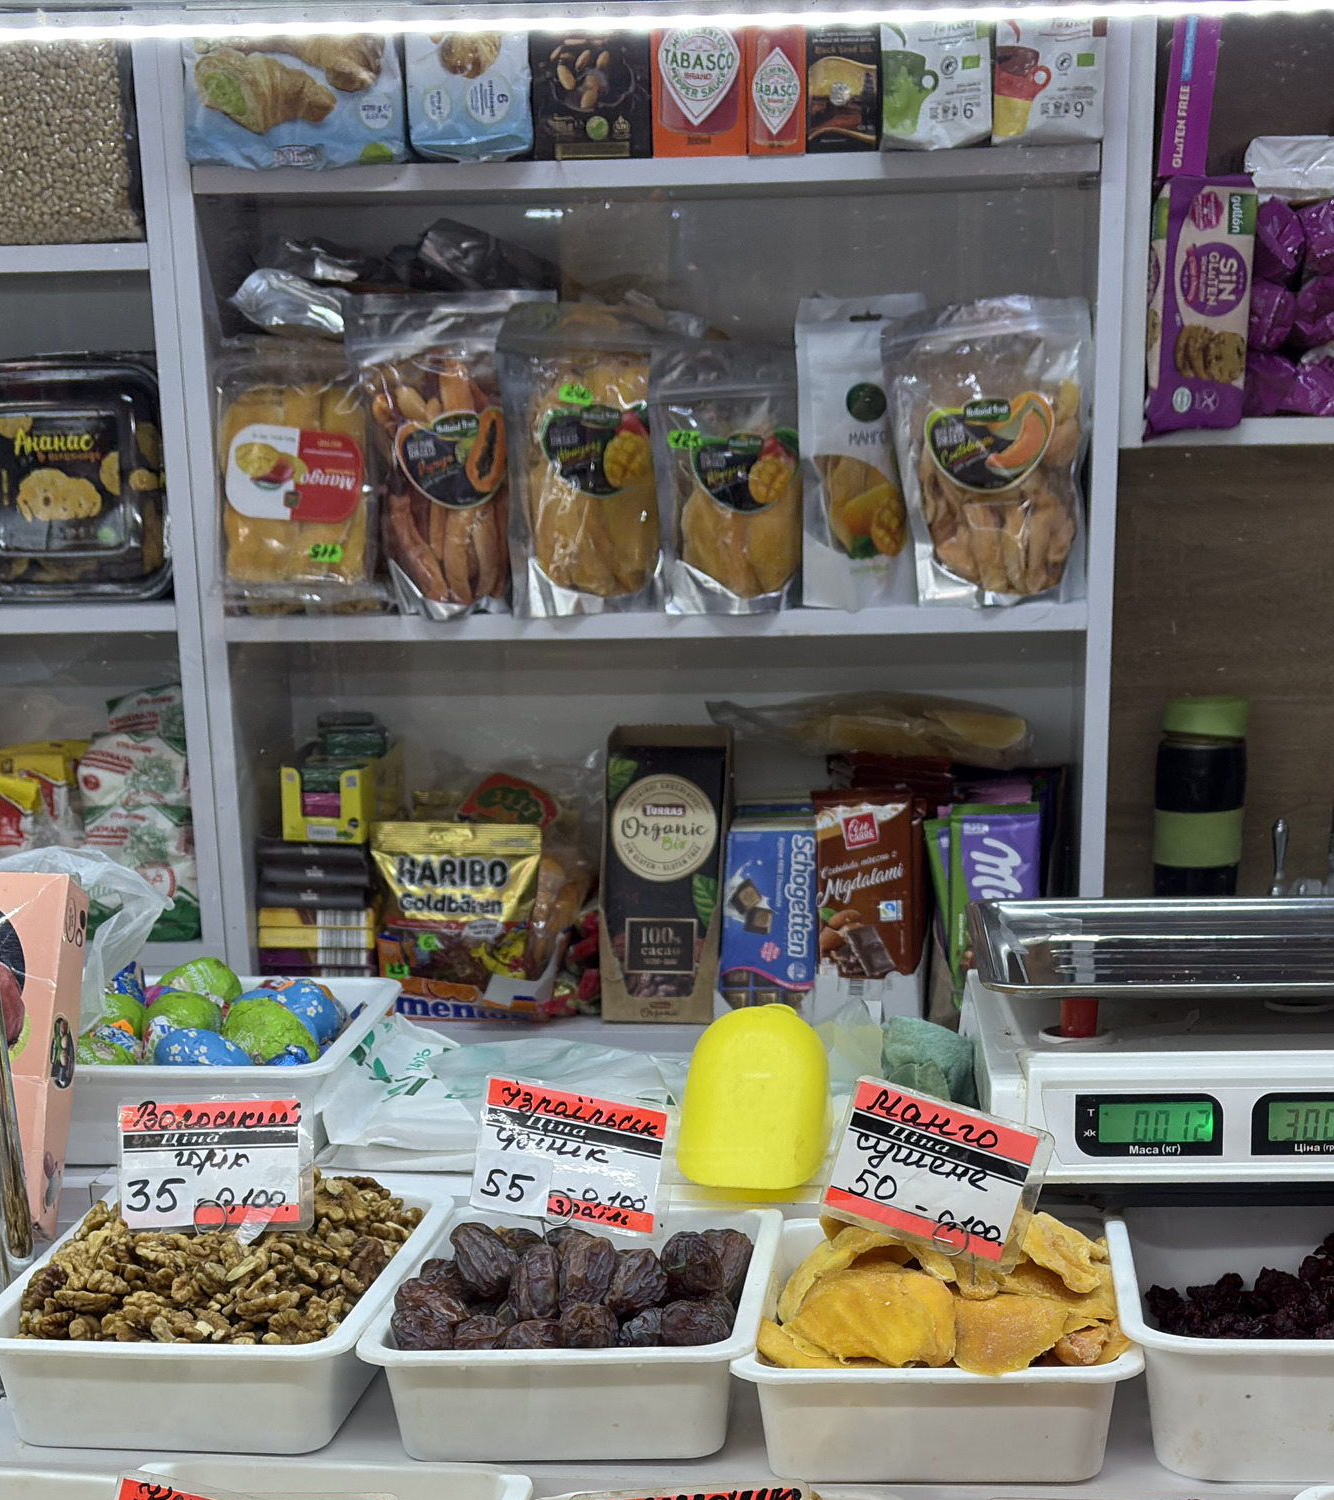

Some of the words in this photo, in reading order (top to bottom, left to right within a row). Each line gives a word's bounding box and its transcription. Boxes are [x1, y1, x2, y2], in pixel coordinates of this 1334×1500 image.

[665, 47, 735, 71] TABASCO
[754, 79, 800, 98] TABASCO
[1176, 84, 1191, 120] FREE
[1171, 121, 1190, 169] GLUTEN
[1231, 195, 1244, 234] gullón
[1207, 251, 1222, 307] GLUTEN
[15, 428, 95, 456] Ананас
[621, 816, 707, 841] Organic
[396, 855, 510, 888] HARIBO
[399, 891, 504, 920] Goldbären
[784, 834, 816, 959] Schogetten
[160, 1133, 220, 1146] Ціна
[526, 1116, 587, 1137] Ціна
[887, 1125, 950, 1154] Ціна
[856, 1133, 989, 1192] сушене
[1129, 1145, 1159, 1154] Маса
[1162, 1144, 1181, 1155] (кг)
[1294, 1143, 1321, 1154] Ціна
[126, 1177, 187, 1213] 35
[480, 1168, 536, 1202] 55
[848, 1169, 897, 1201] 50
